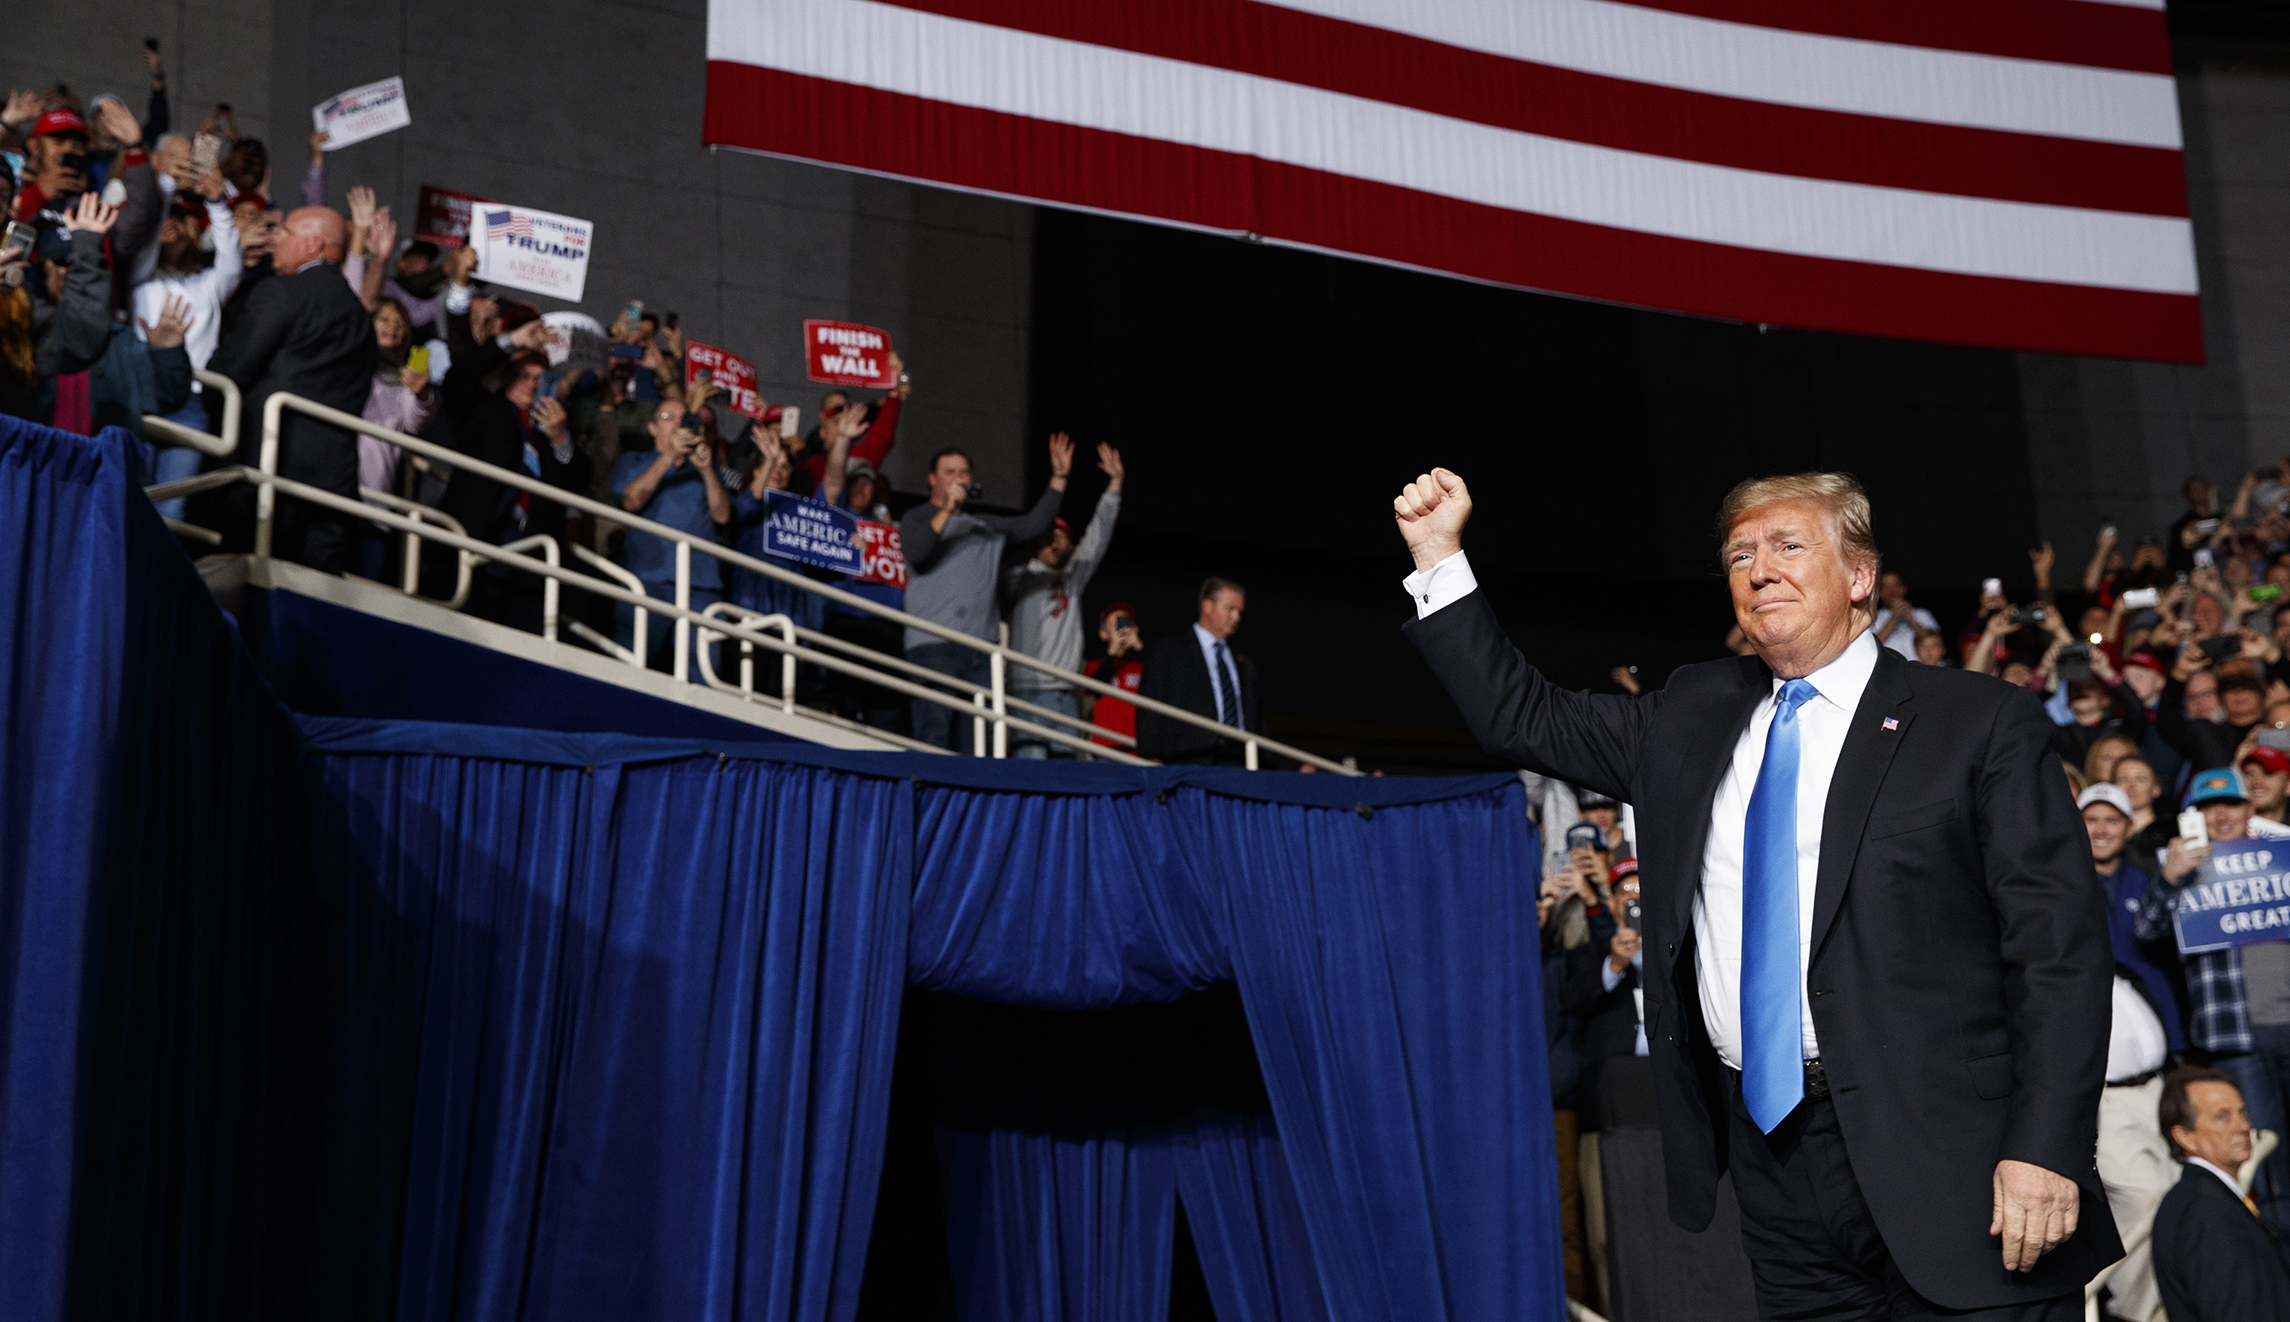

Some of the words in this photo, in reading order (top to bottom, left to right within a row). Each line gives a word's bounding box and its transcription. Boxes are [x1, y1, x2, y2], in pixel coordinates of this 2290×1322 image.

[506, 231, 585, 260] TRUMP
[817, 326, 883, 350] FINISH
[688, 346, 723, 367] GET
[820, 353, 881, 378] WALL
[796, 504, 831, 524] MAKE
[768, 511, 854, 548] AMERIC
[775, 530, 810, 551] SAFE
[809, 541, 853, 562] AGAIN
[2212, 850, 2273, 875] KEEP
